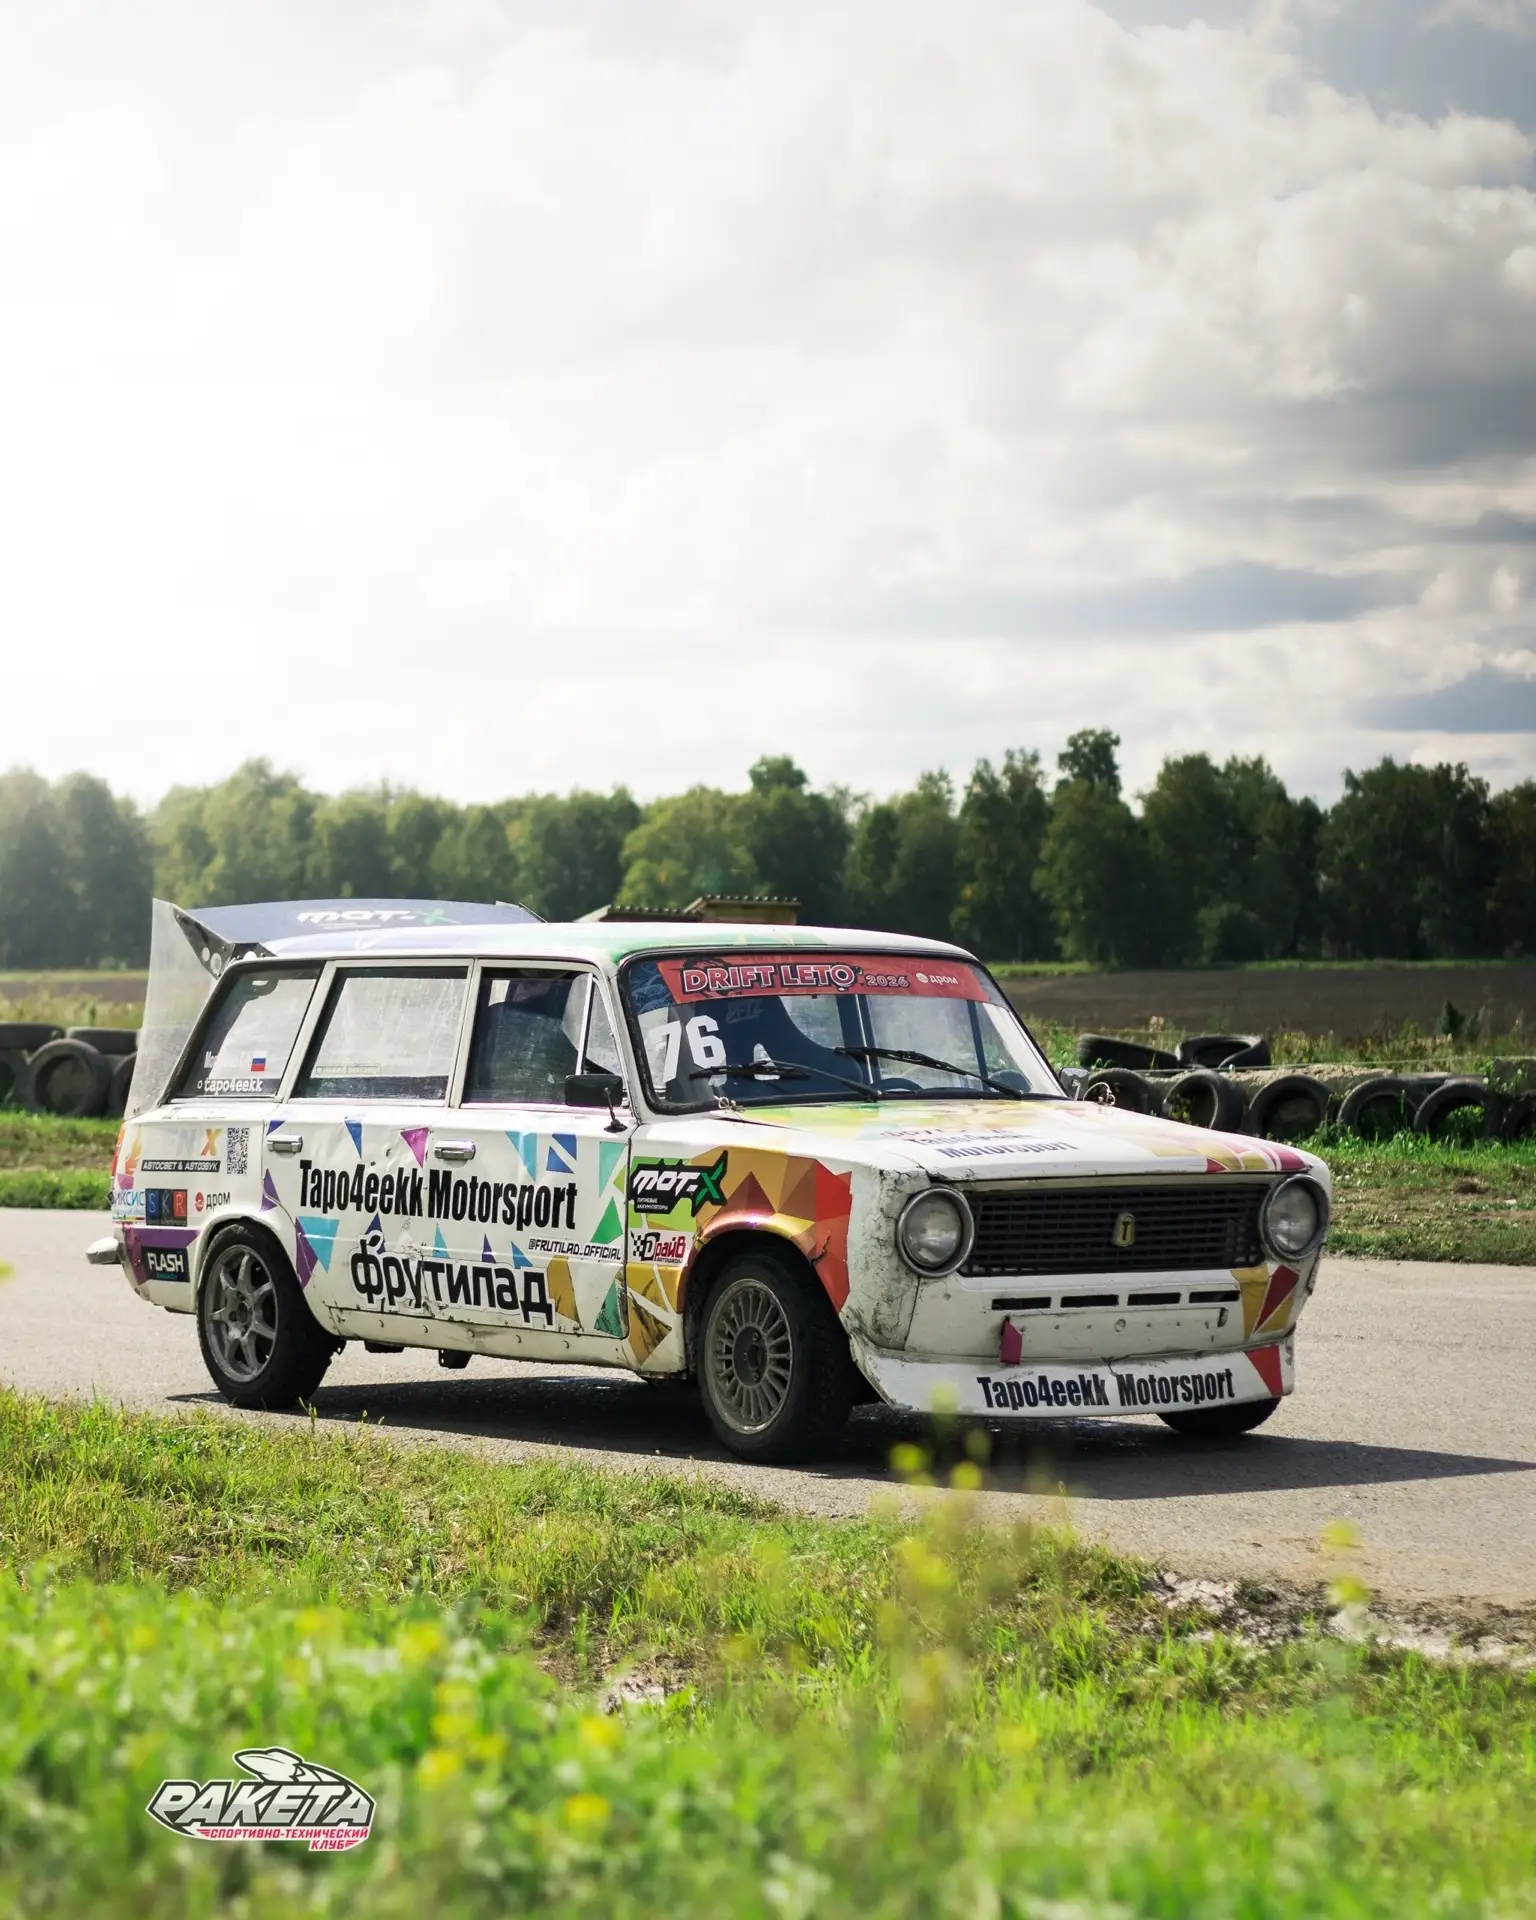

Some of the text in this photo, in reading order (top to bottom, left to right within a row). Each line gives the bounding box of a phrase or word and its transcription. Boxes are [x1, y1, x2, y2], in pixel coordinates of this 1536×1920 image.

[683, 964, 854, 993] DRIFT LETO
[865, 974, 908, 988] 2026
[935, 1141, 1079, 1158] Motorsport
[143, 1161, 176, 1170] АВТОСВЕТ
[149, 1192, 186, 1217] SKR
[299, 1159, 578, 1231] Tapo4eekk Motorsport
[528, 1238, 621, 1260] @FRUTILAD_OFFICIAL
[147, 1253, 184, 1273] FLASH
[976, 1368, 1235, 1410] Tapo4eekk Motorsport
